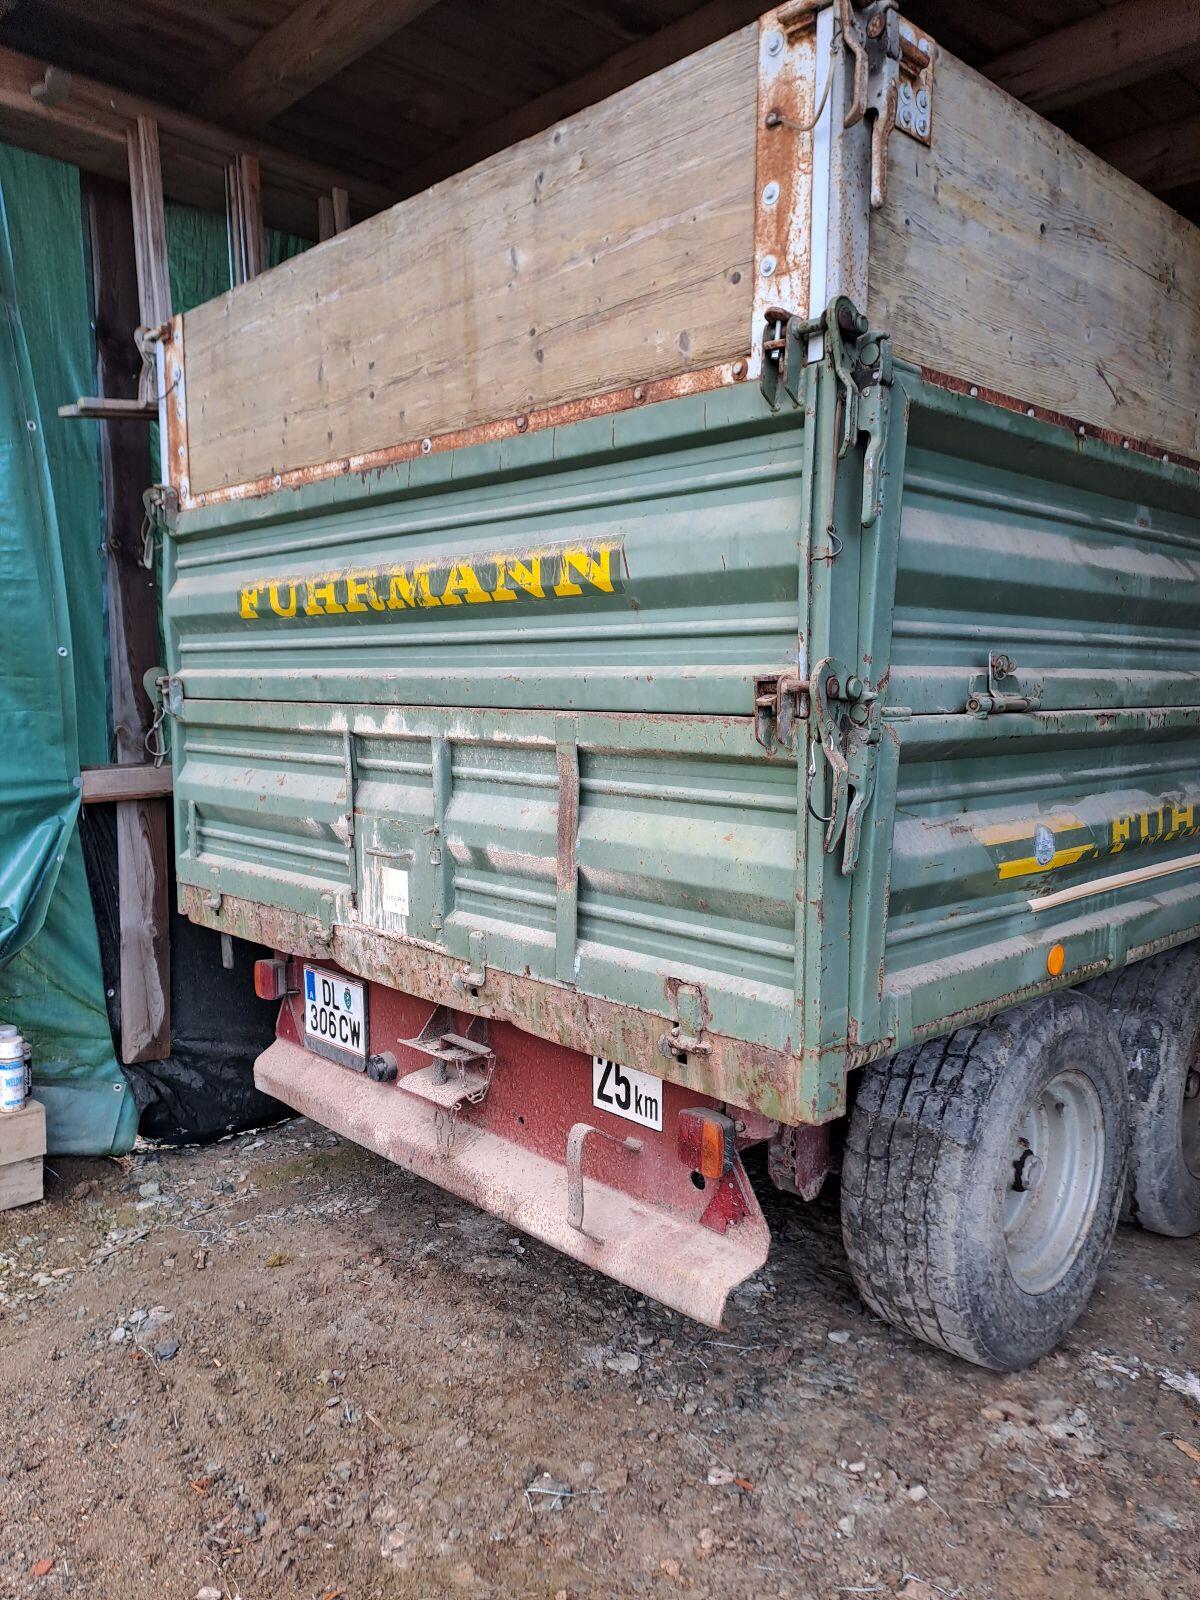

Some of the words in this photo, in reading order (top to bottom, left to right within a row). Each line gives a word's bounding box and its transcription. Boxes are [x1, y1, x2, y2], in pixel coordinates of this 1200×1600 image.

[239, 542, 615, 619] FUHRMANN
[322, 978, 340, 1010] DL
[597, 1058, 631, 1110] 25
[634, 1084, 659, 1122] km
